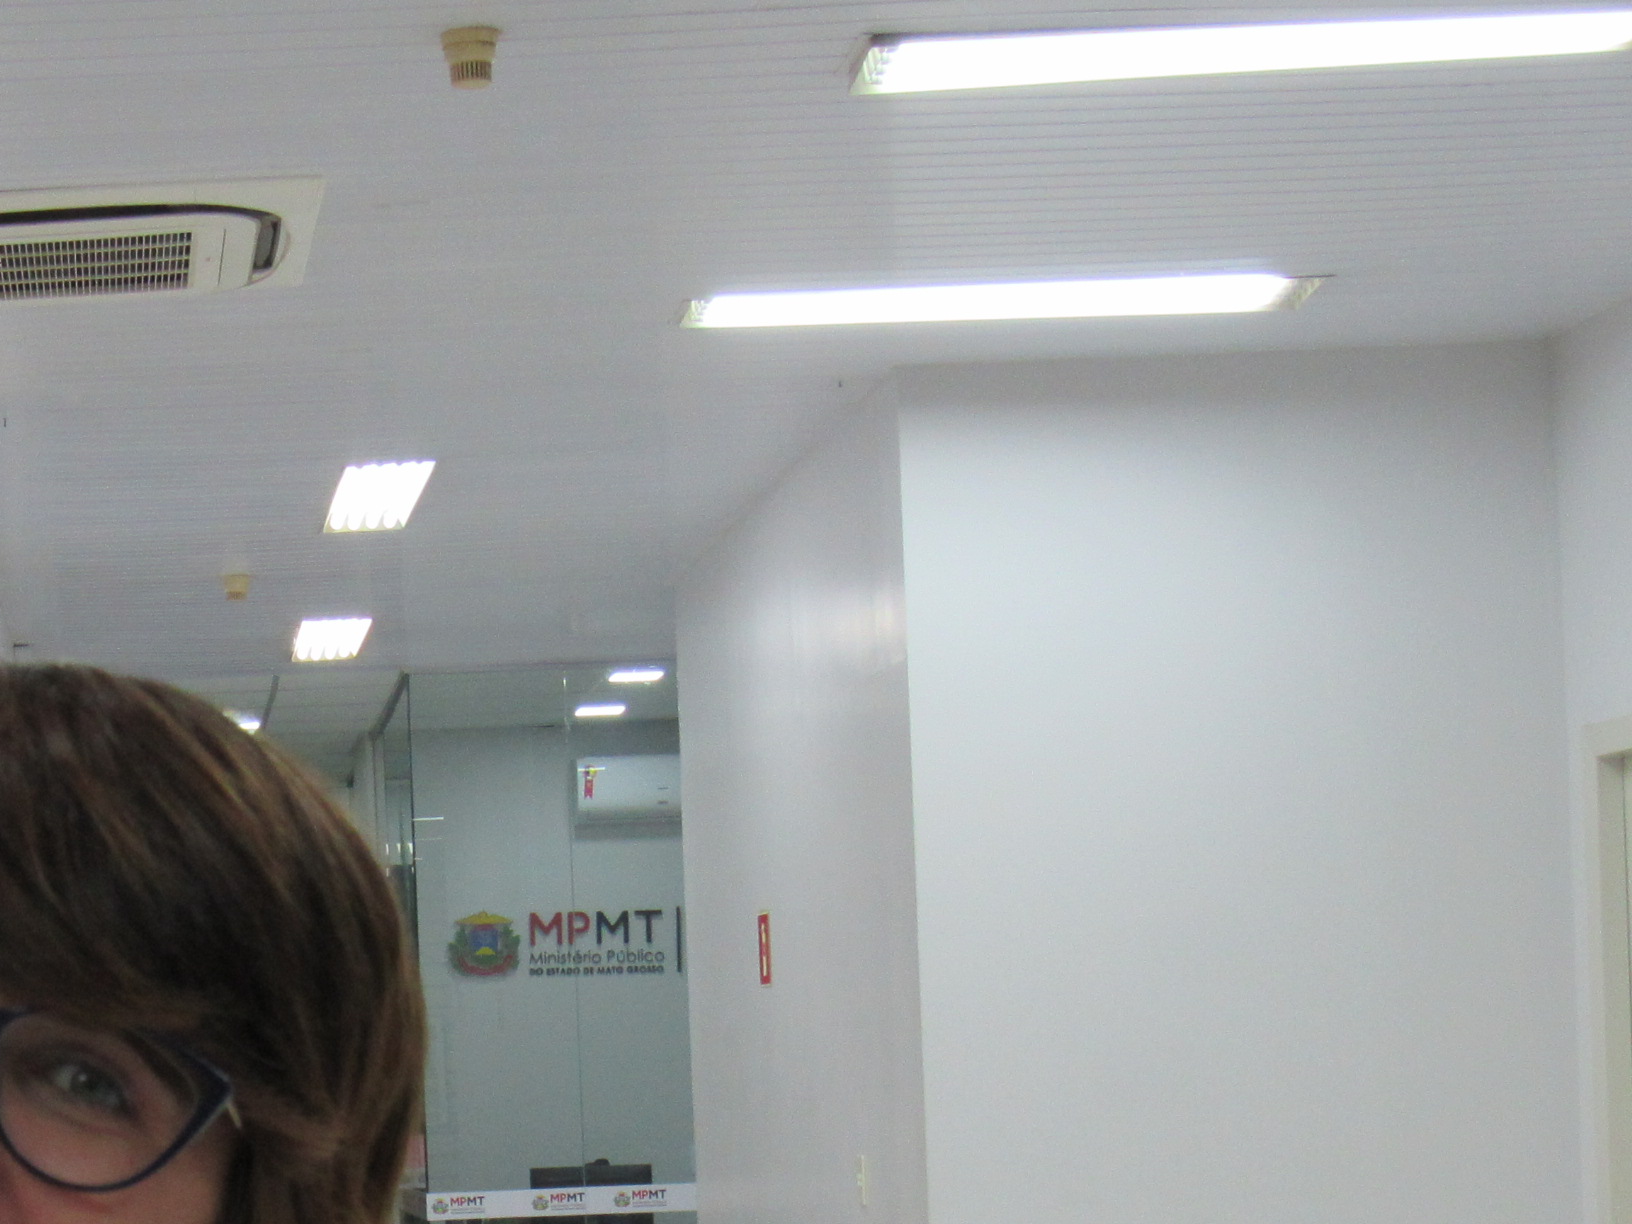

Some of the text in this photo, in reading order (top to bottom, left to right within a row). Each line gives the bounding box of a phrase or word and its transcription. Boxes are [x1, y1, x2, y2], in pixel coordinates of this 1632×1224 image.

[529, 910, 663, 946] MPMT
[530, 948, 665, 965] Ministério Público
[529, 967, 544, 976] DO
[546, 966, 581, 976] ESTADO
[583, 966, 595, 975] DE
[597, 965, 624, 975] MATO
[550, 1192, 585, 1203] MPMT
[632, 1189, 667, 1199] MPMT
[450, 1196, 485, 1206] MPMT
